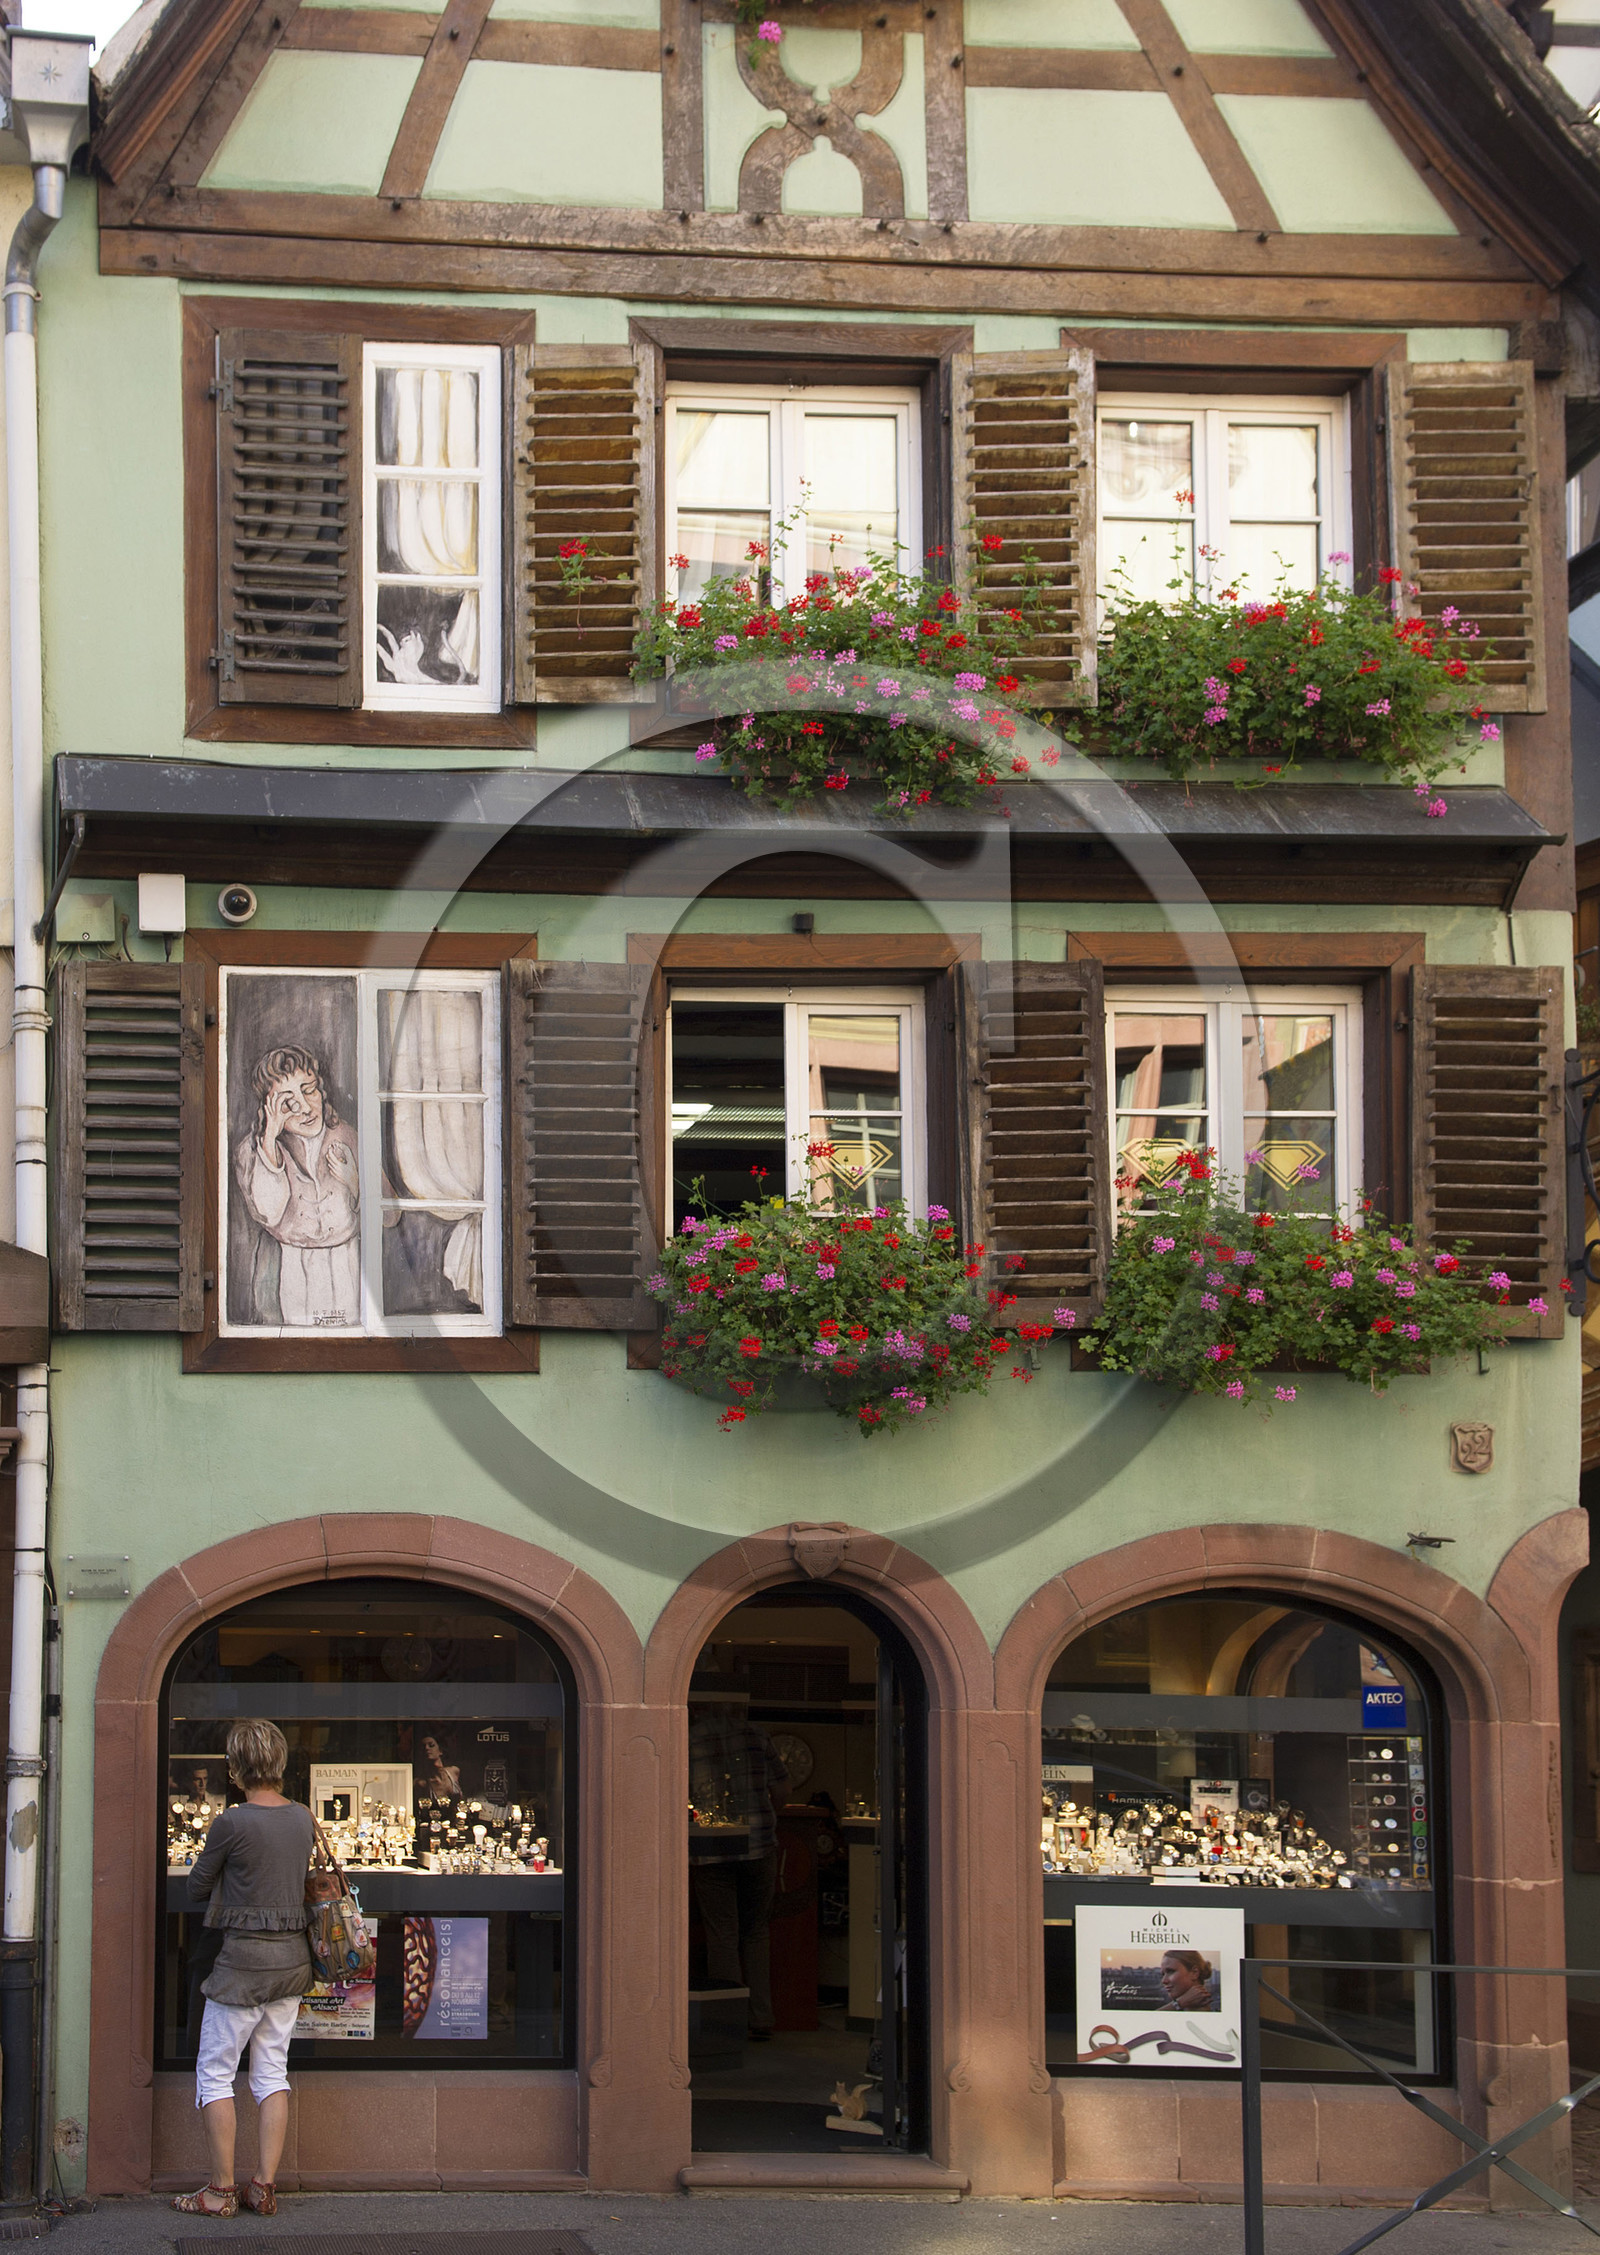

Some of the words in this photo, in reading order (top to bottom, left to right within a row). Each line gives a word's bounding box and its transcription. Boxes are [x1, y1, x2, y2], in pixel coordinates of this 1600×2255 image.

[1461, 1431, 1490, 1464] 22
[1366, 1692, 1403, 1705] AKTEO
[477, 1733, 510, 1742] LOTUS
[315, 1768, 358, 1779] BALMAIN
[1041, 1769, 1067, 1779] ELIN
[1111, 1797, 1164, 1805] HAMILTON
[1130, 1931, 1190, 1944] HERBELIN
